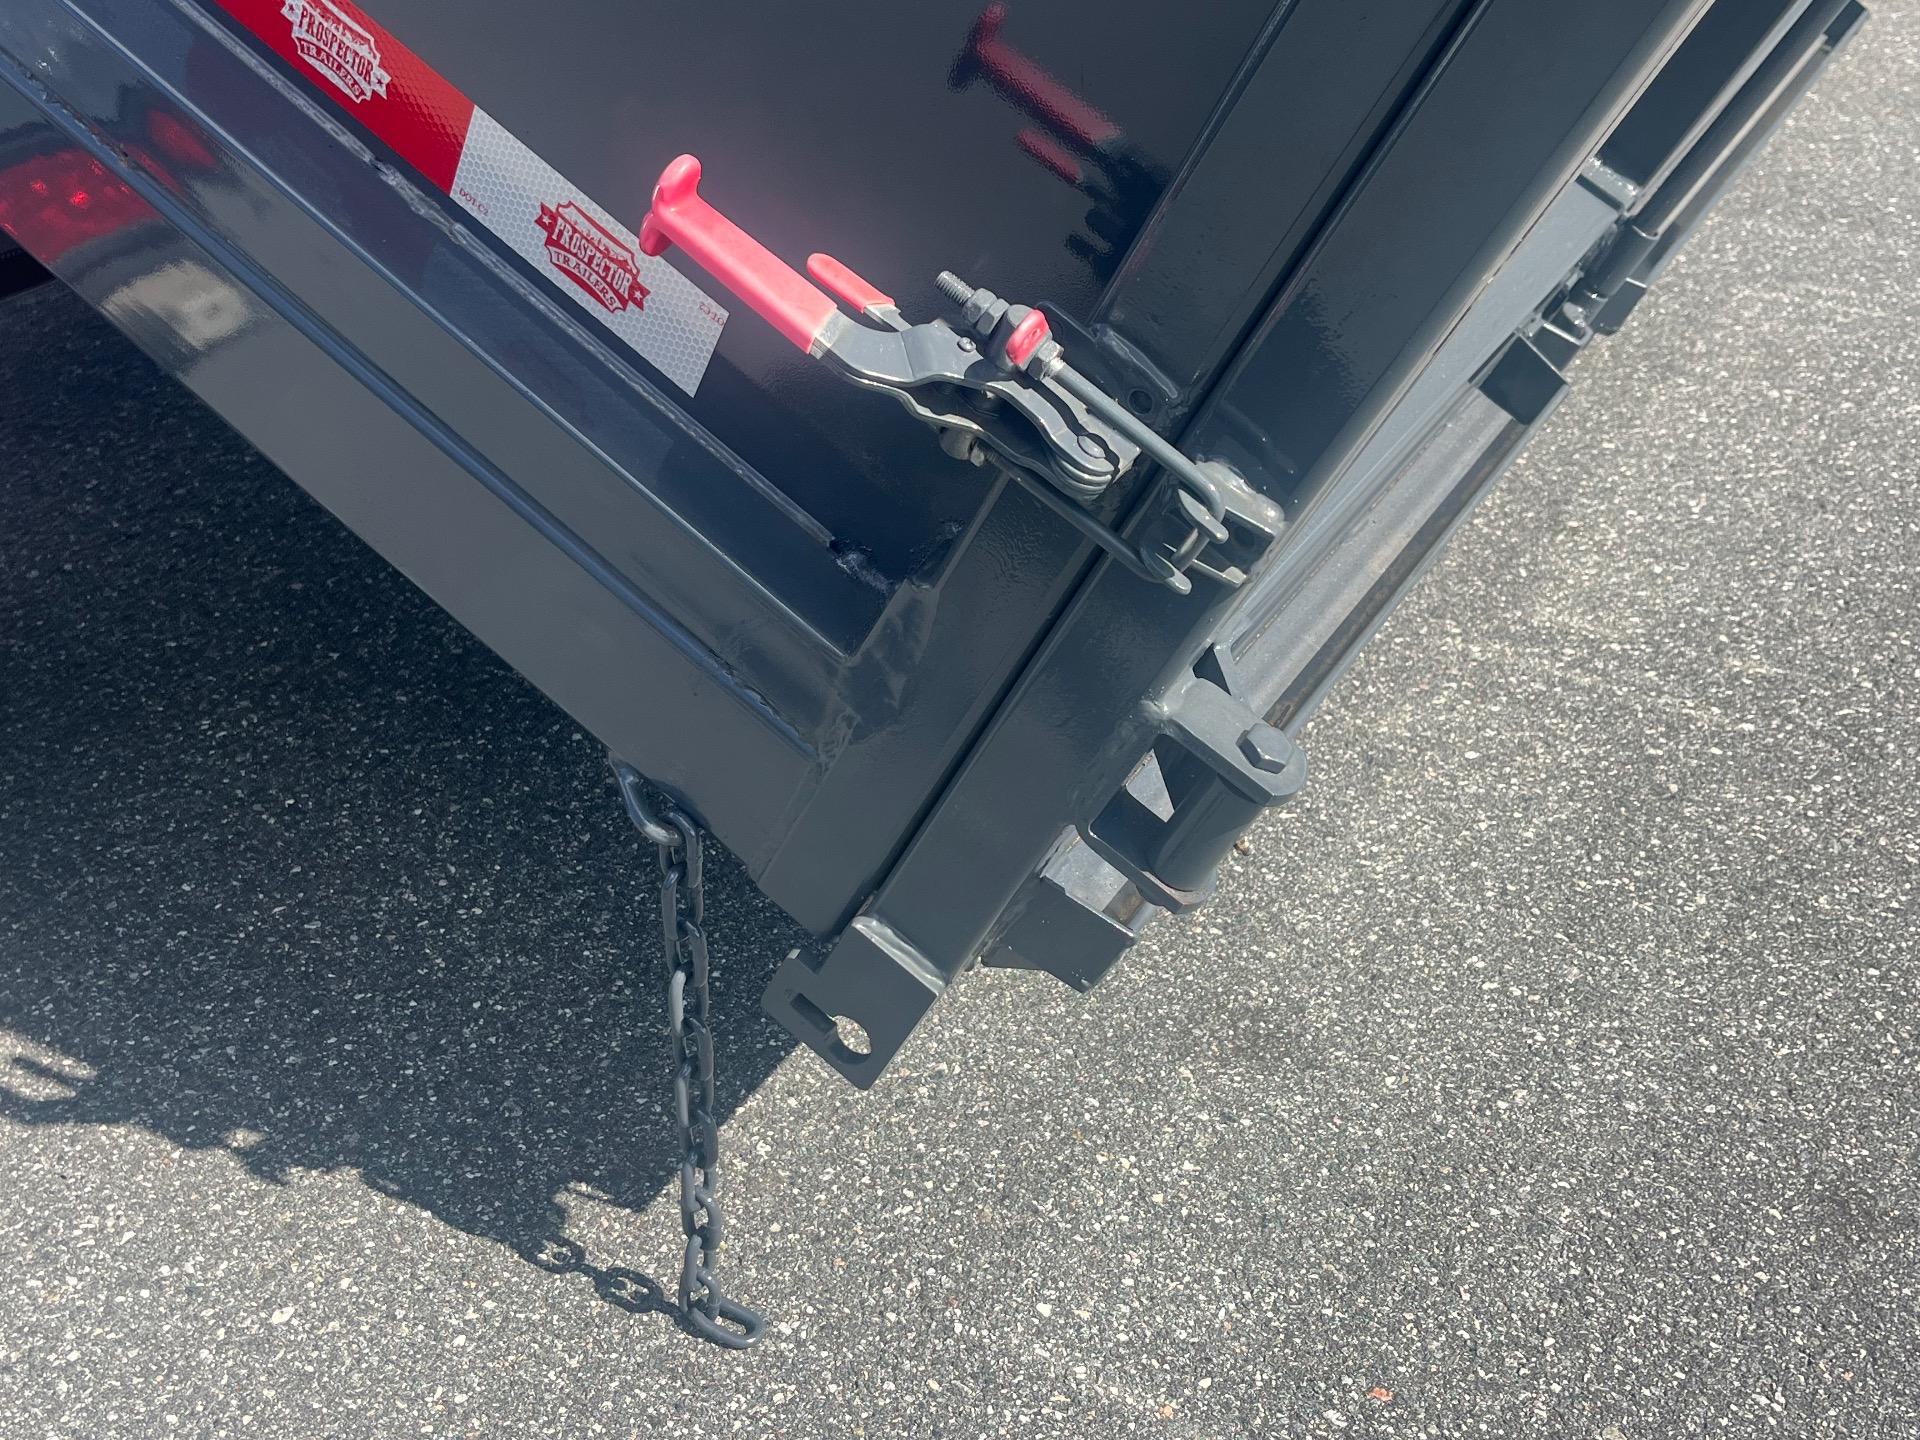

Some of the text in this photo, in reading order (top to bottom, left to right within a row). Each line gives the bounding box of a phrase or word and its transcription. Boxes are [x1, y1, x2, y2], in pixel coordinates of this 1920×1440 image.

[299, 4, 374, 87] PROSPECTOR
[301, 41, 362, 96] TRAILERS
[551, 216, 633, 300] PROSPECTOR
[554, 251, 617, 306] TRAILERS
